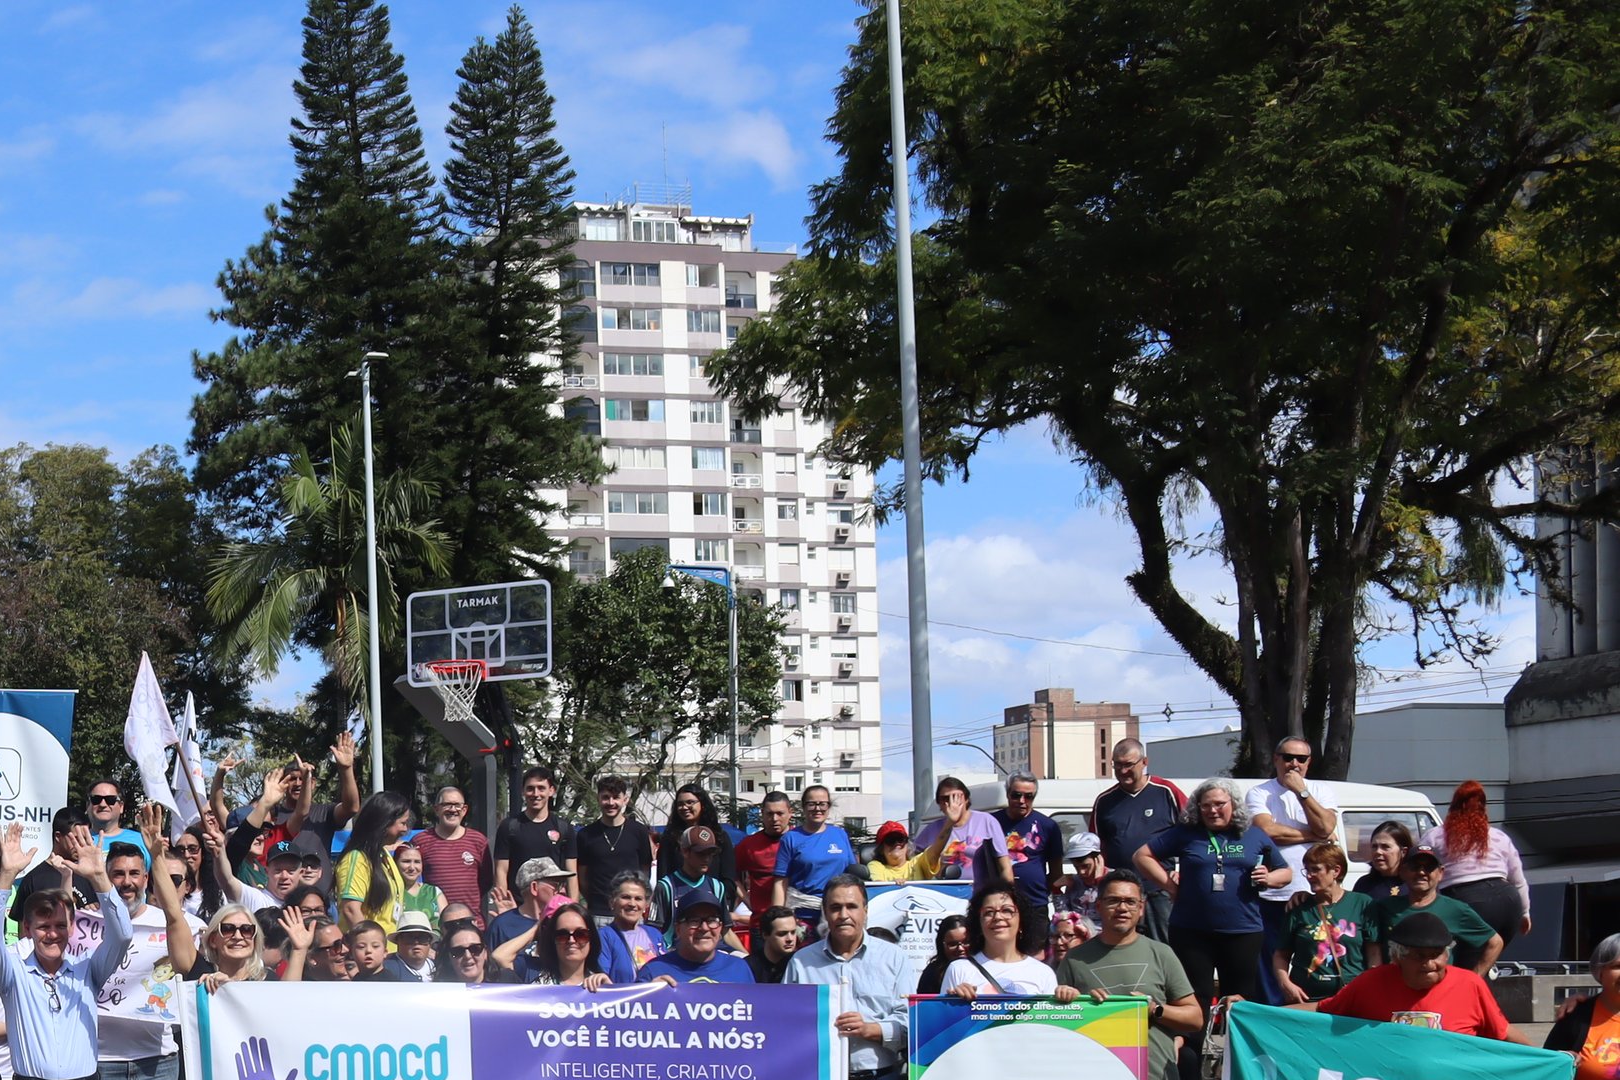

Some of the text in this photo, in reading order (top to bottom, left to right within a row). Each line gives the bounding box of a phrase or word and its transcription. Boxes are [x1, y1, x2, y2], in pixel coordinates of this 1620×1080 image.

[457, 596, 498, 608] TARMAK
[538, 999, 752, 1021] SOU IGUAL A VOCÊ!
[970, 1001, 1002, 1010] Somos
[1004, 1002, 1031, 1010] todos
[1015, 1013, 1033, 1021] algo
[527, 1025, 765, 1049] VOCÊ É IGUAL A NÓS?
[541, 1062, 757, 1080] INTELIGENTE, CRIATIVO,
